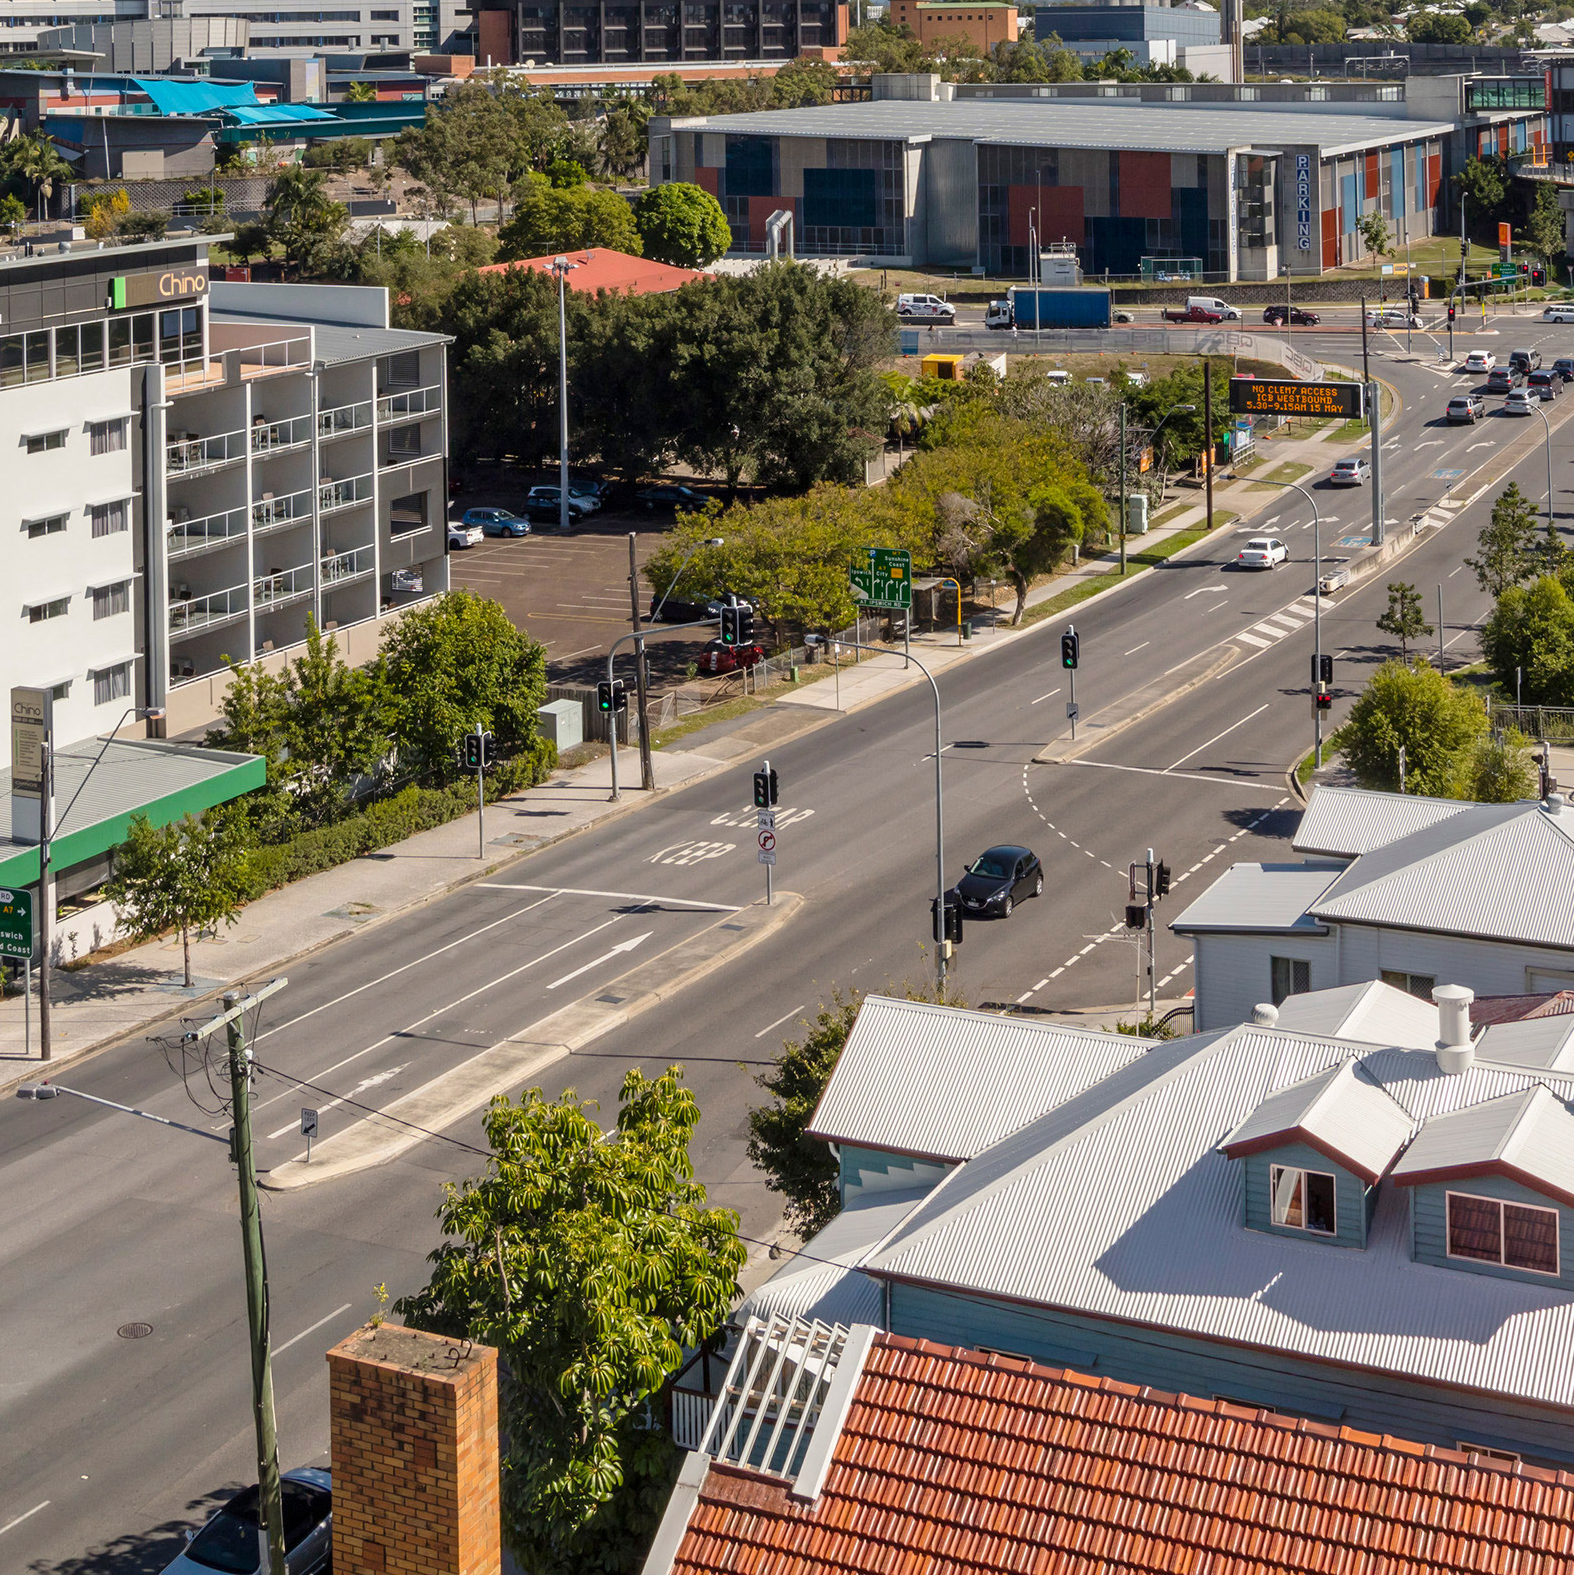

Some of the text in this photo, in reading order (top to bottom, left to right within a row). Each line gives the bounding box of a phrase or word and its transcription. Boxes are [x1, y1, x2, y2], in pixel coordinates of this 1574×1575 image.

[1297, 156, 1310, 249] PARKING
[160, 272, 205, 296] Chino
[1252, 385, 1337, 396] NO CLEM7 ACCESS
[1257, 394, 1332, 405] ICB WESTBOUND
[1246, 401, 1343, 413] 5.30-9.15AM 15 MAY
[14, 702, 41, 716] Chino
[710, 805, 815, 831] CLEAR
[642, 840, 737, 866] KEEP
[7, 943, 30, 954] Coast
